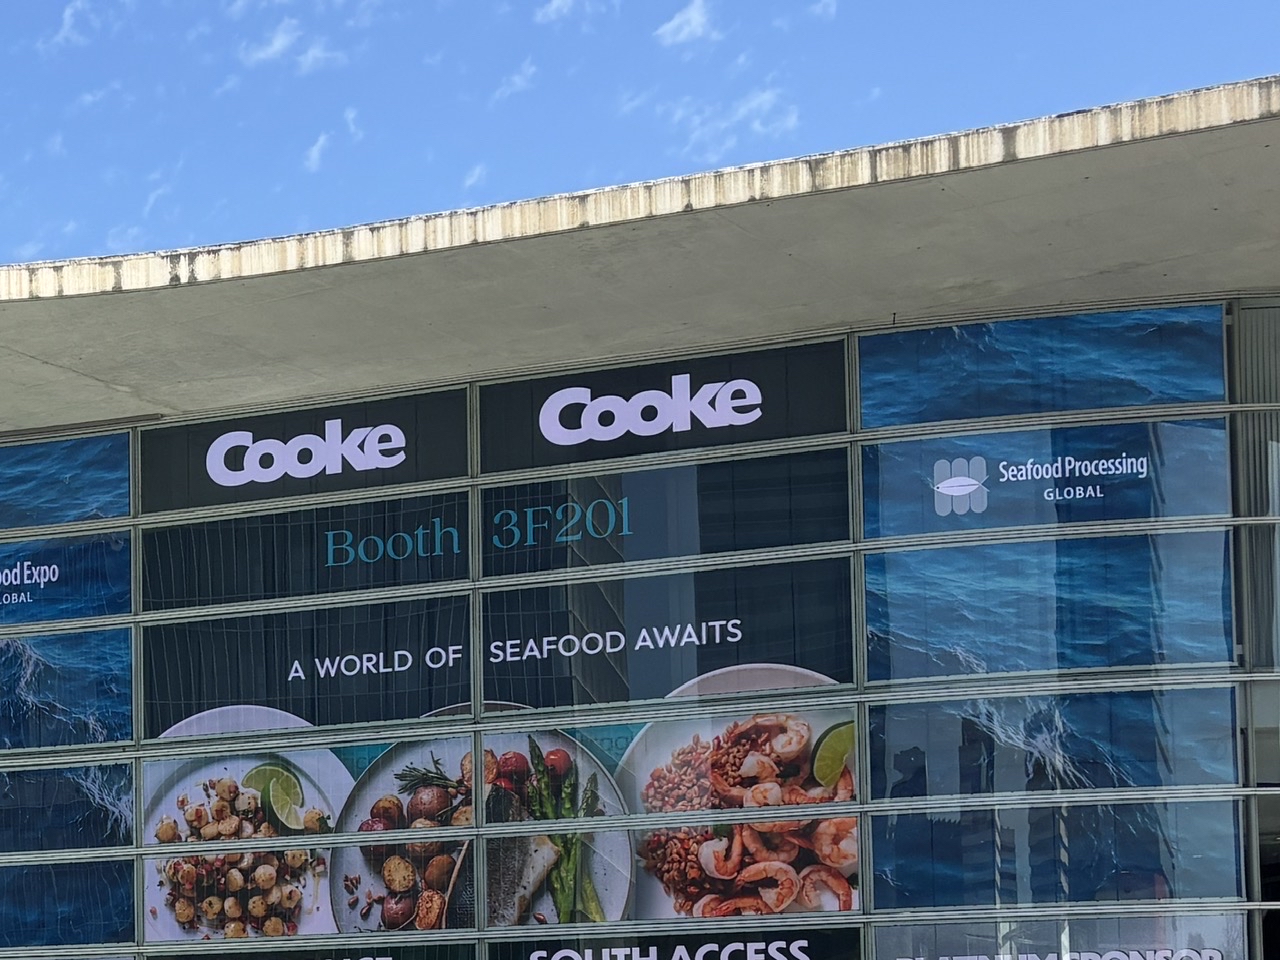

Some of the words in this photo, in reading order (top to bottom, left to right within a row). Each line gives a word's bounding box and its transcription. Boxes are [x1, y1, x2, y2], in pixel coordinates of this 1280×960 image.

[539, 373, 763, 446] Cooke
[205, 418, 407, 487] Cooke
[999, 456, 1062, 483] Seafood
[1064, 452, 1148, 482] Processing
[1043, 485, 1104, 501] GLOBAL
[325, 517, 461, 567] Booth
[491, 496, 634, 550] 3F201
[23, 560, 59, 588] Expo
[287, 659, 306, 681] A
[314, 650, 413, 678] WORLD
[425, 645, 463, 669] OF
[489, 631, 626, 664] SEAFOOD
[634, 619, 743, 651] AWAITS
